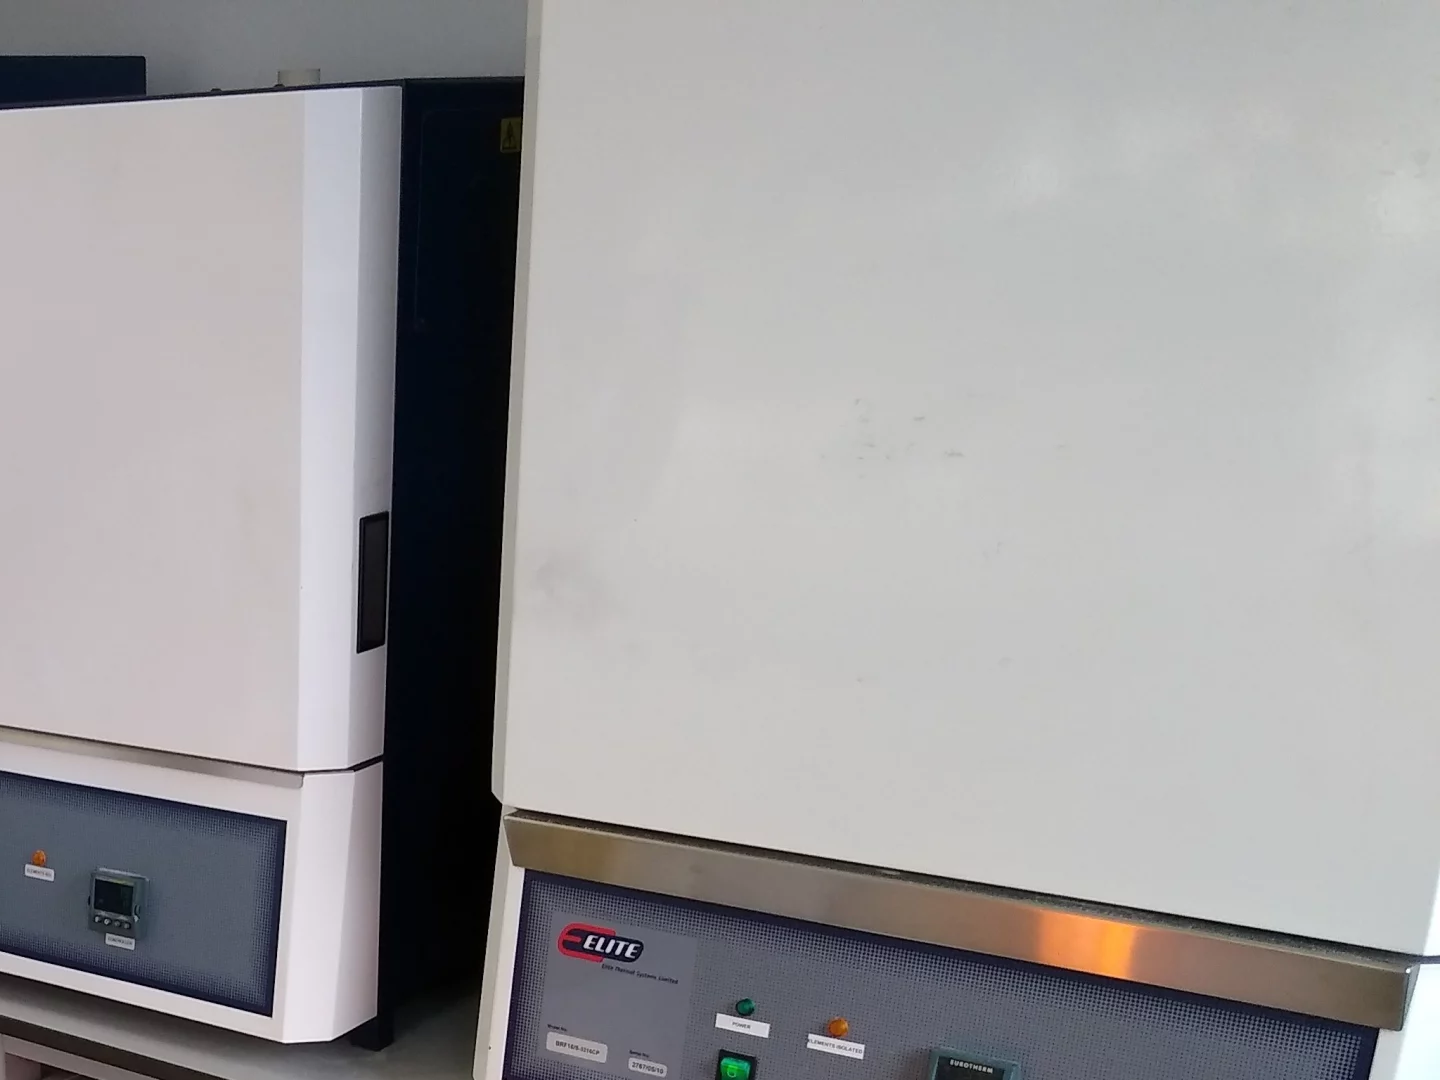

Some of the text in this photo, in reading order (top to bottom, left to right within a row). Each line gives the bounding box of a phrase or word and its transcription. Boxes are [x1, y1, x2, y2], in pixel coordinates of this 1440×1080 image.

[583, 934, 641, 959] ELITE
[731, 1021, 751, 1030] POWER
[949, 1059, 994, 1074] EUROTHERM
